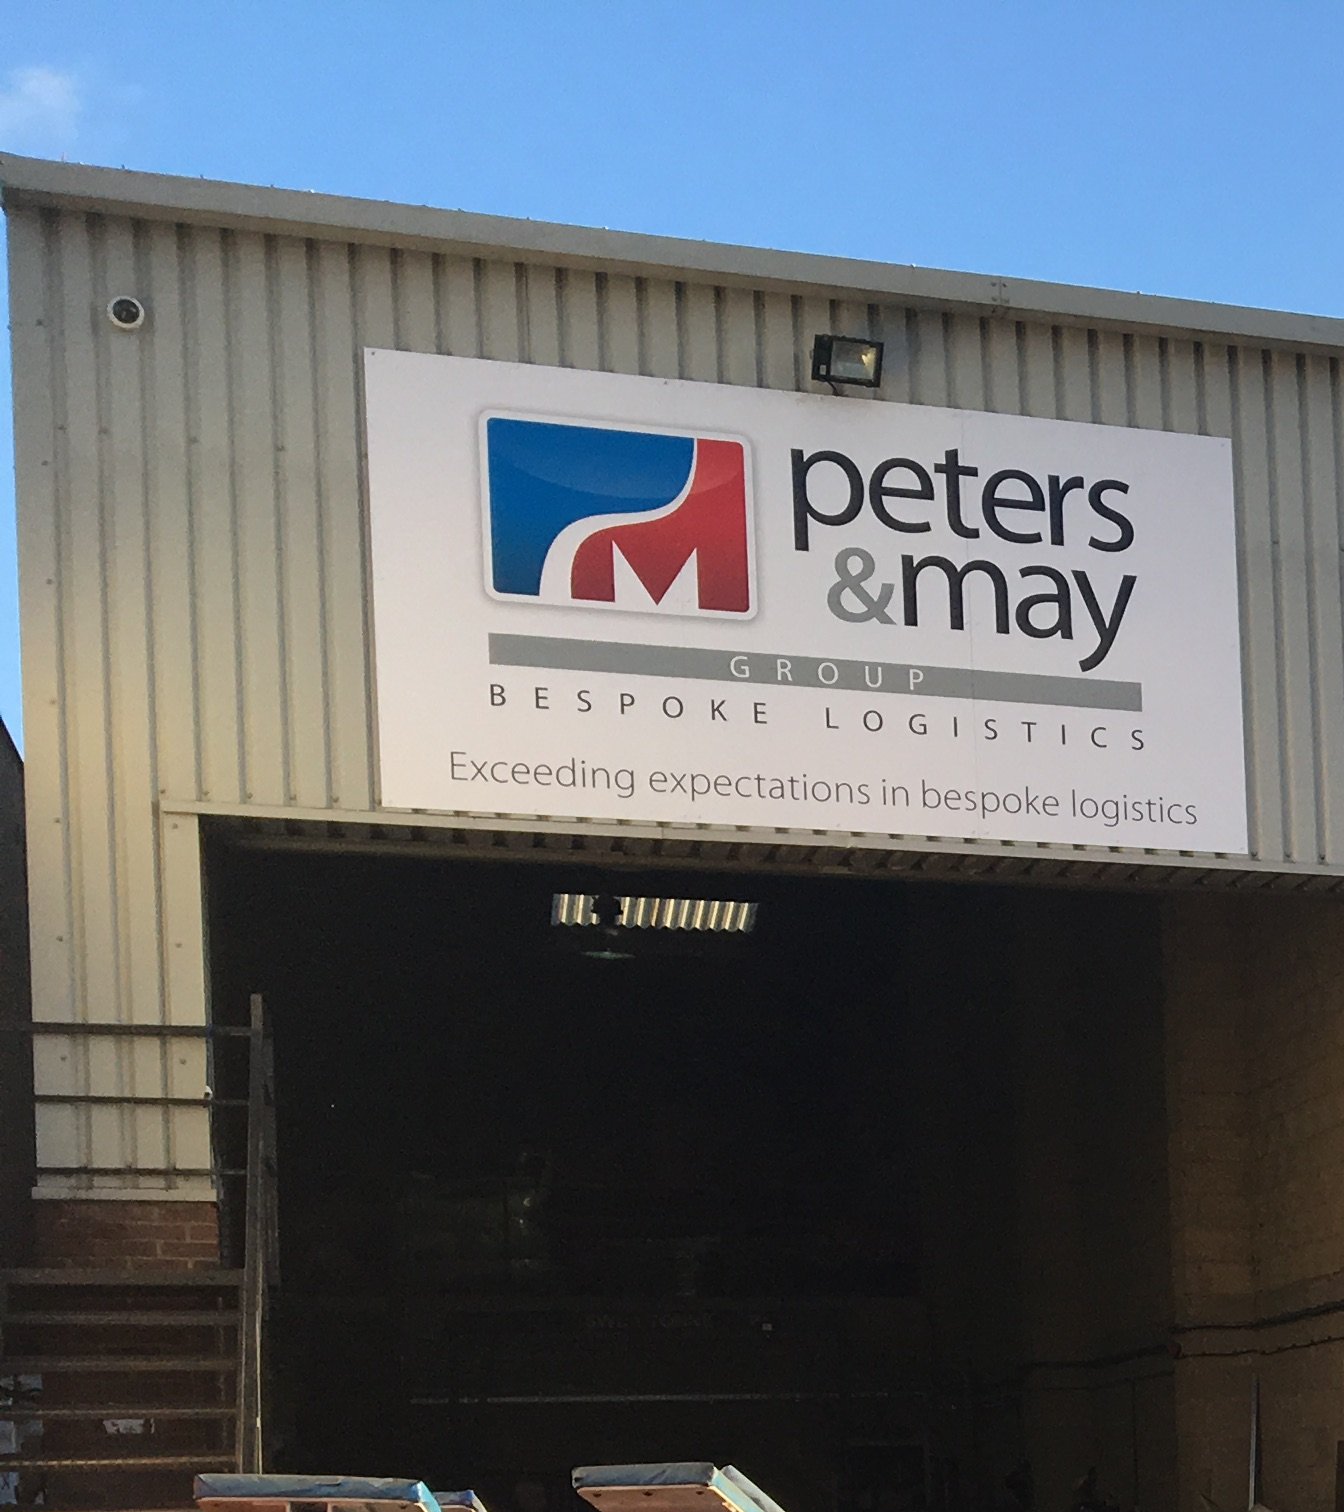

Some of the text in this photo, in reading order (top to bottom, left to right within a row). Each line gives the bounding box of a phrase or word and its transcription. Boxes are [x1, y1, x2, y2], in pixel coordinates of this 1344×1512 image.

[790, 447, 1136, 554] peters
[729, 655, 925, 691] GROUP
[489, 683, 1145, 751] BESPOKE LOGISTICS
[450, 750, 1199, 828] Exceeding expectations in bespoke logistics
